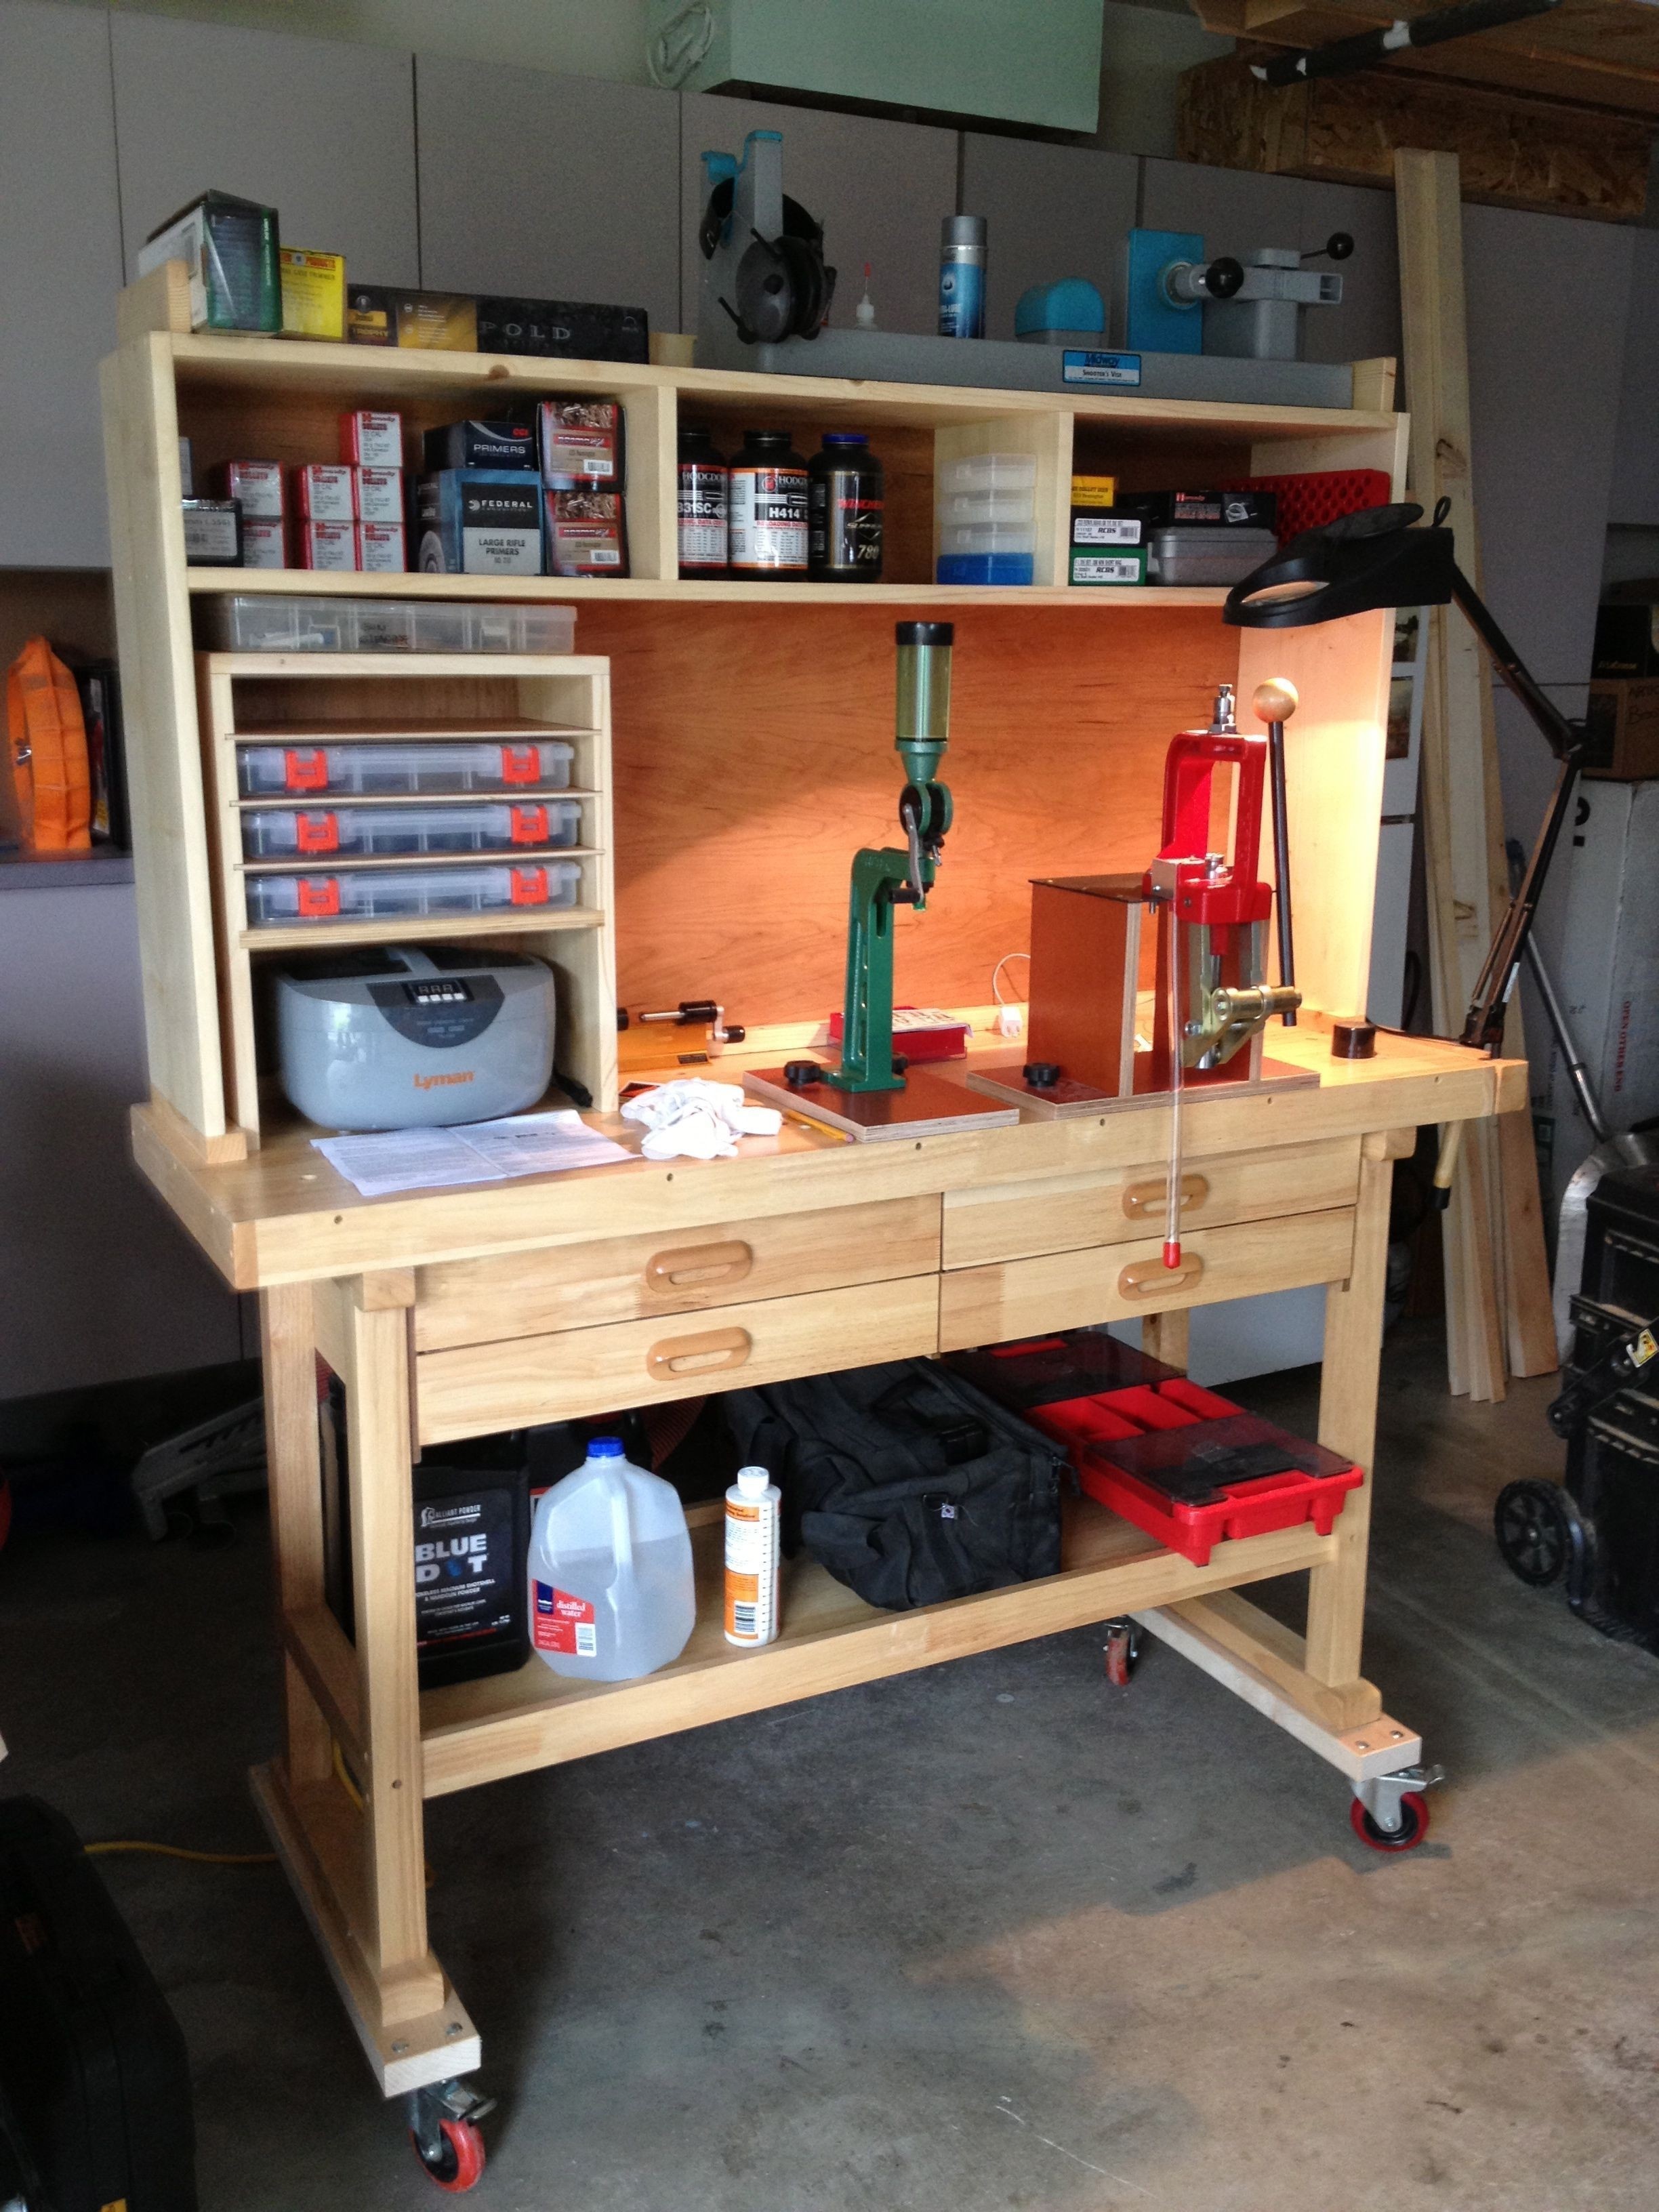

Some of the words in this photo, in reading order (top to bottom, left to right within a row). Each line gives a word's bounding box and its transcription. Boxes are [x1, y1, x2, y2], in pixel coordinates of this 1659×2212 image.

[1085, 353, 1120, 366] Midway
[473, 444, 527, 454] PRIMERS
[481, 499, 533, 508] FEDERAL
[769, 507, 800, 518] H414
[857, 544, 880, 559] 780
[1622, 1001, 1631, 1029] OPEN
[1616, 1032, 1627, 1067] OTHER
[414, 1071, 474, 1091] Lyman
[1615, 1071, 1624, 1092] END
[435, 1508, 458, 1518] ALLIANT
[458, 1504, 481, 1515] POWDER
[415, 1533, 487, 1562] BLUE
[466, 1578, 496, 1589] SHOTSHELL
[457, 1586, 480, 1596] POWDER
[556, 1600, 586, 1611] distilled
[560, 1609, 582, 1618] water
